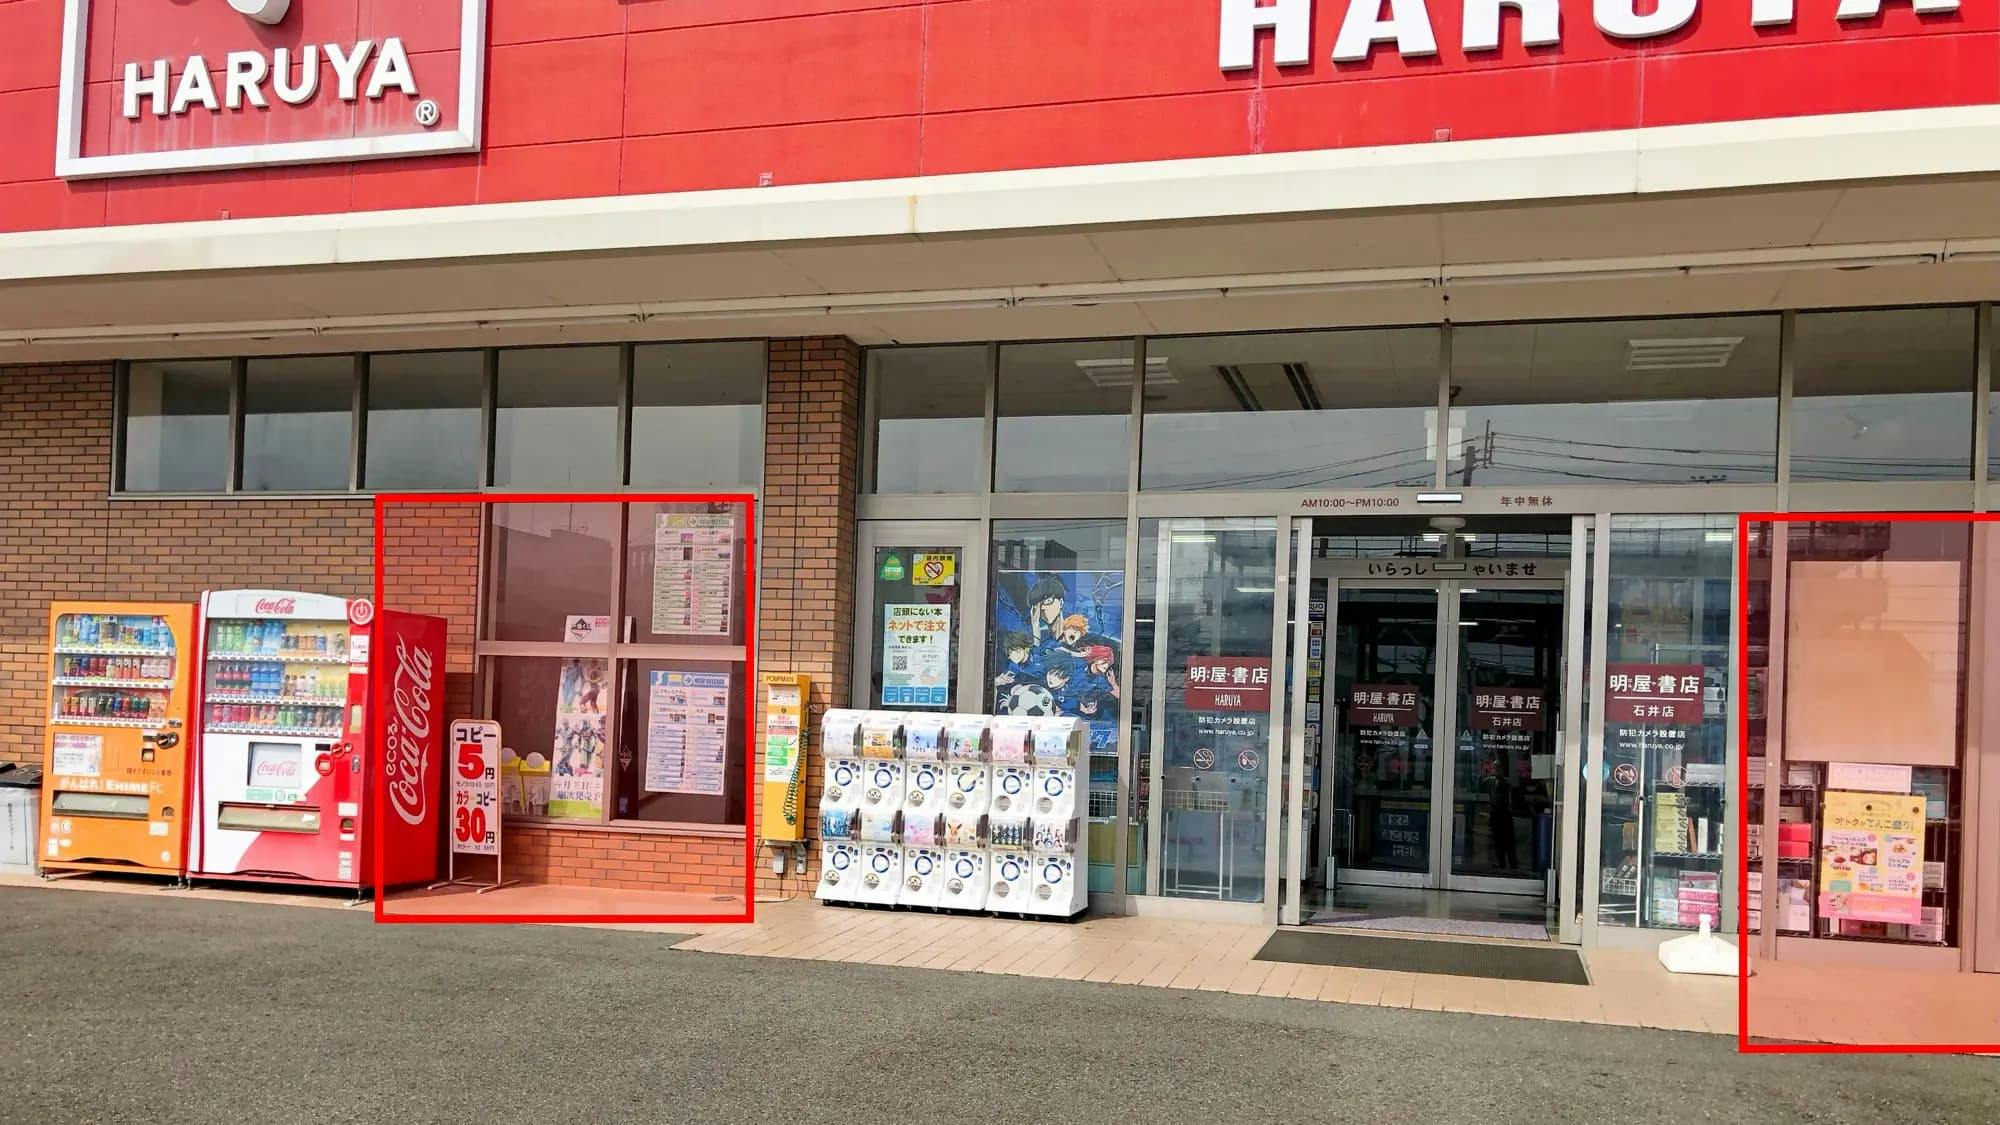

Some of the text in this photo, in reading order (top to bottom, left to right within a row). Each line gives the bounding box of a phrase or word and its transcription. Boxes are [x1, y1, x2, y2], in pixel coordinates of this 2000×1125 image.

[123, 38, 418, 118] HARUYA
[1500, 496, 1553, 507] 年中無休
[255, 598, 296, 615] Coca-Cola
[893, 607, 943, 617] 店頭にない本
[888, 619, 946, 632] ネットで注文
[898, 635, 934, 644] できます！
[1215, 694, 1242, 707] HARUYA
[1633, 704, 1675, 717] 石井店
[1492, 716, 1522, 727] 石井店
[389, 632, 433, 826] Coca-Cola
[456, 726, 497, 743] コピー
[1619, 728, 1686, 739] 防犯カメラ設置店
